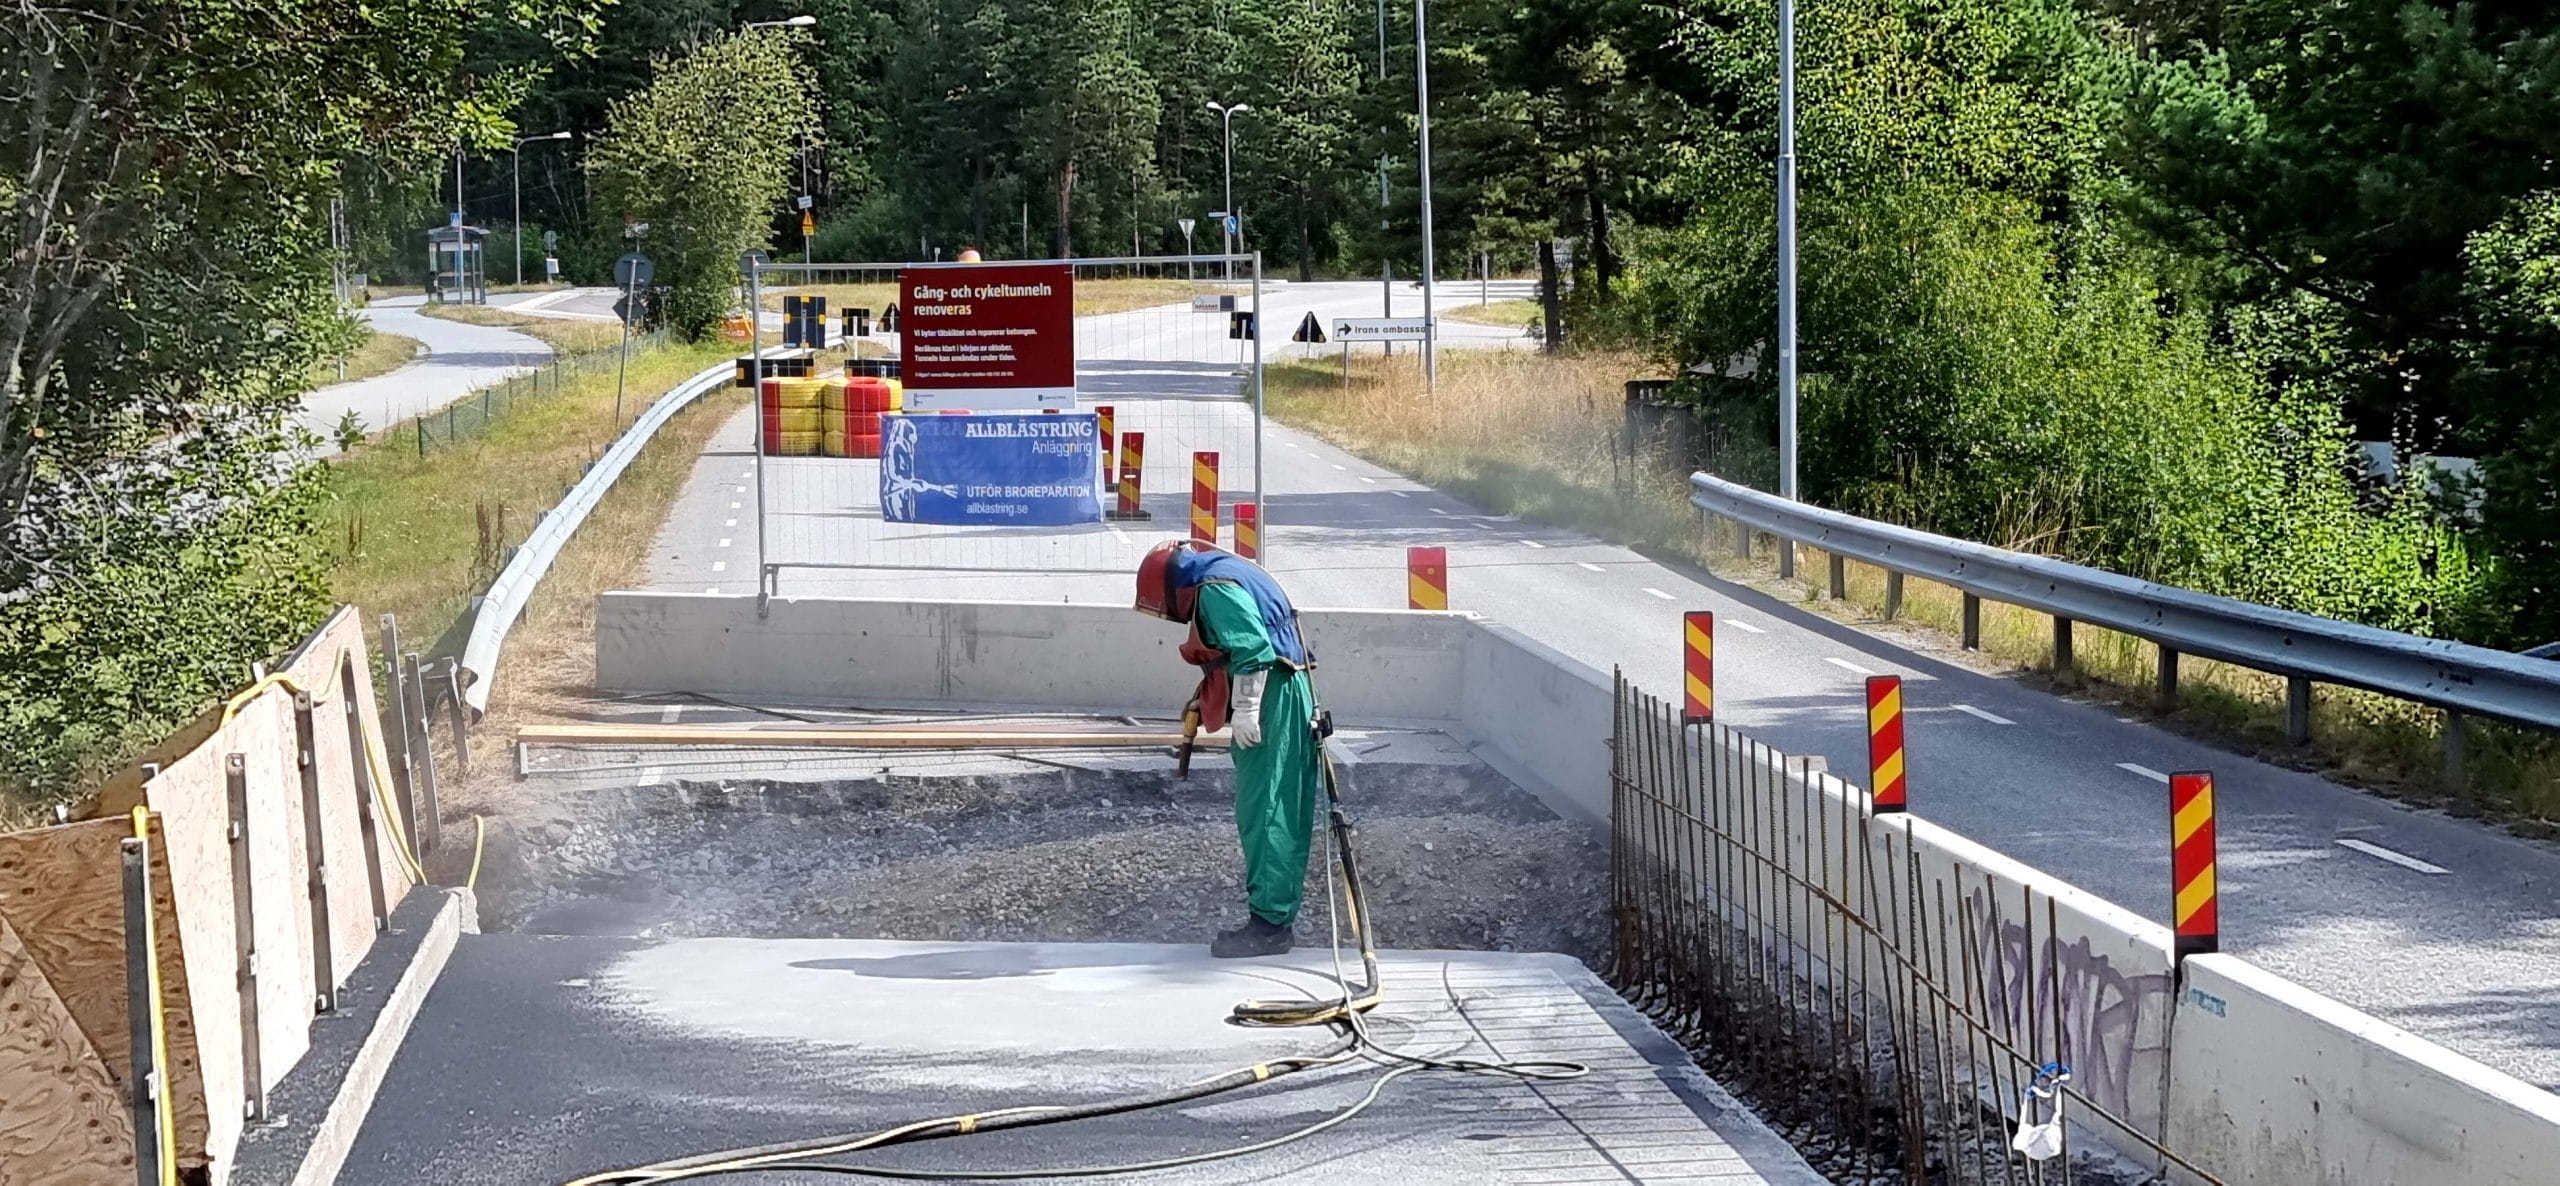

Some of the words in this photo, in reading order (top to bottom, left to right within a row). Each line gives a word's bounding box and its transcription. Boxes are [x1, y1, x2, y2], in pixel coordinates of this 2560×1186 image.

[913, 285, 948, 301] Gång-
[950, 284, 972, 299] och
[974, 282, 1052, 300] cykeltunneln
[913, 304, 972, 316] renoveras
[1354, 325, 1379, 334] Irans
[1382, 324, 1426, 334] ambassa
[965, 419, 1093, 438] ALLBLÄSTRING
[1031, 440, 1092, 457] Anläggning
[966, 483, 1002, 498] UTFÖR
[1004, 484, 1090, 498] BROREPARATION
[966, 502, 1029, 515] allblastring.se
